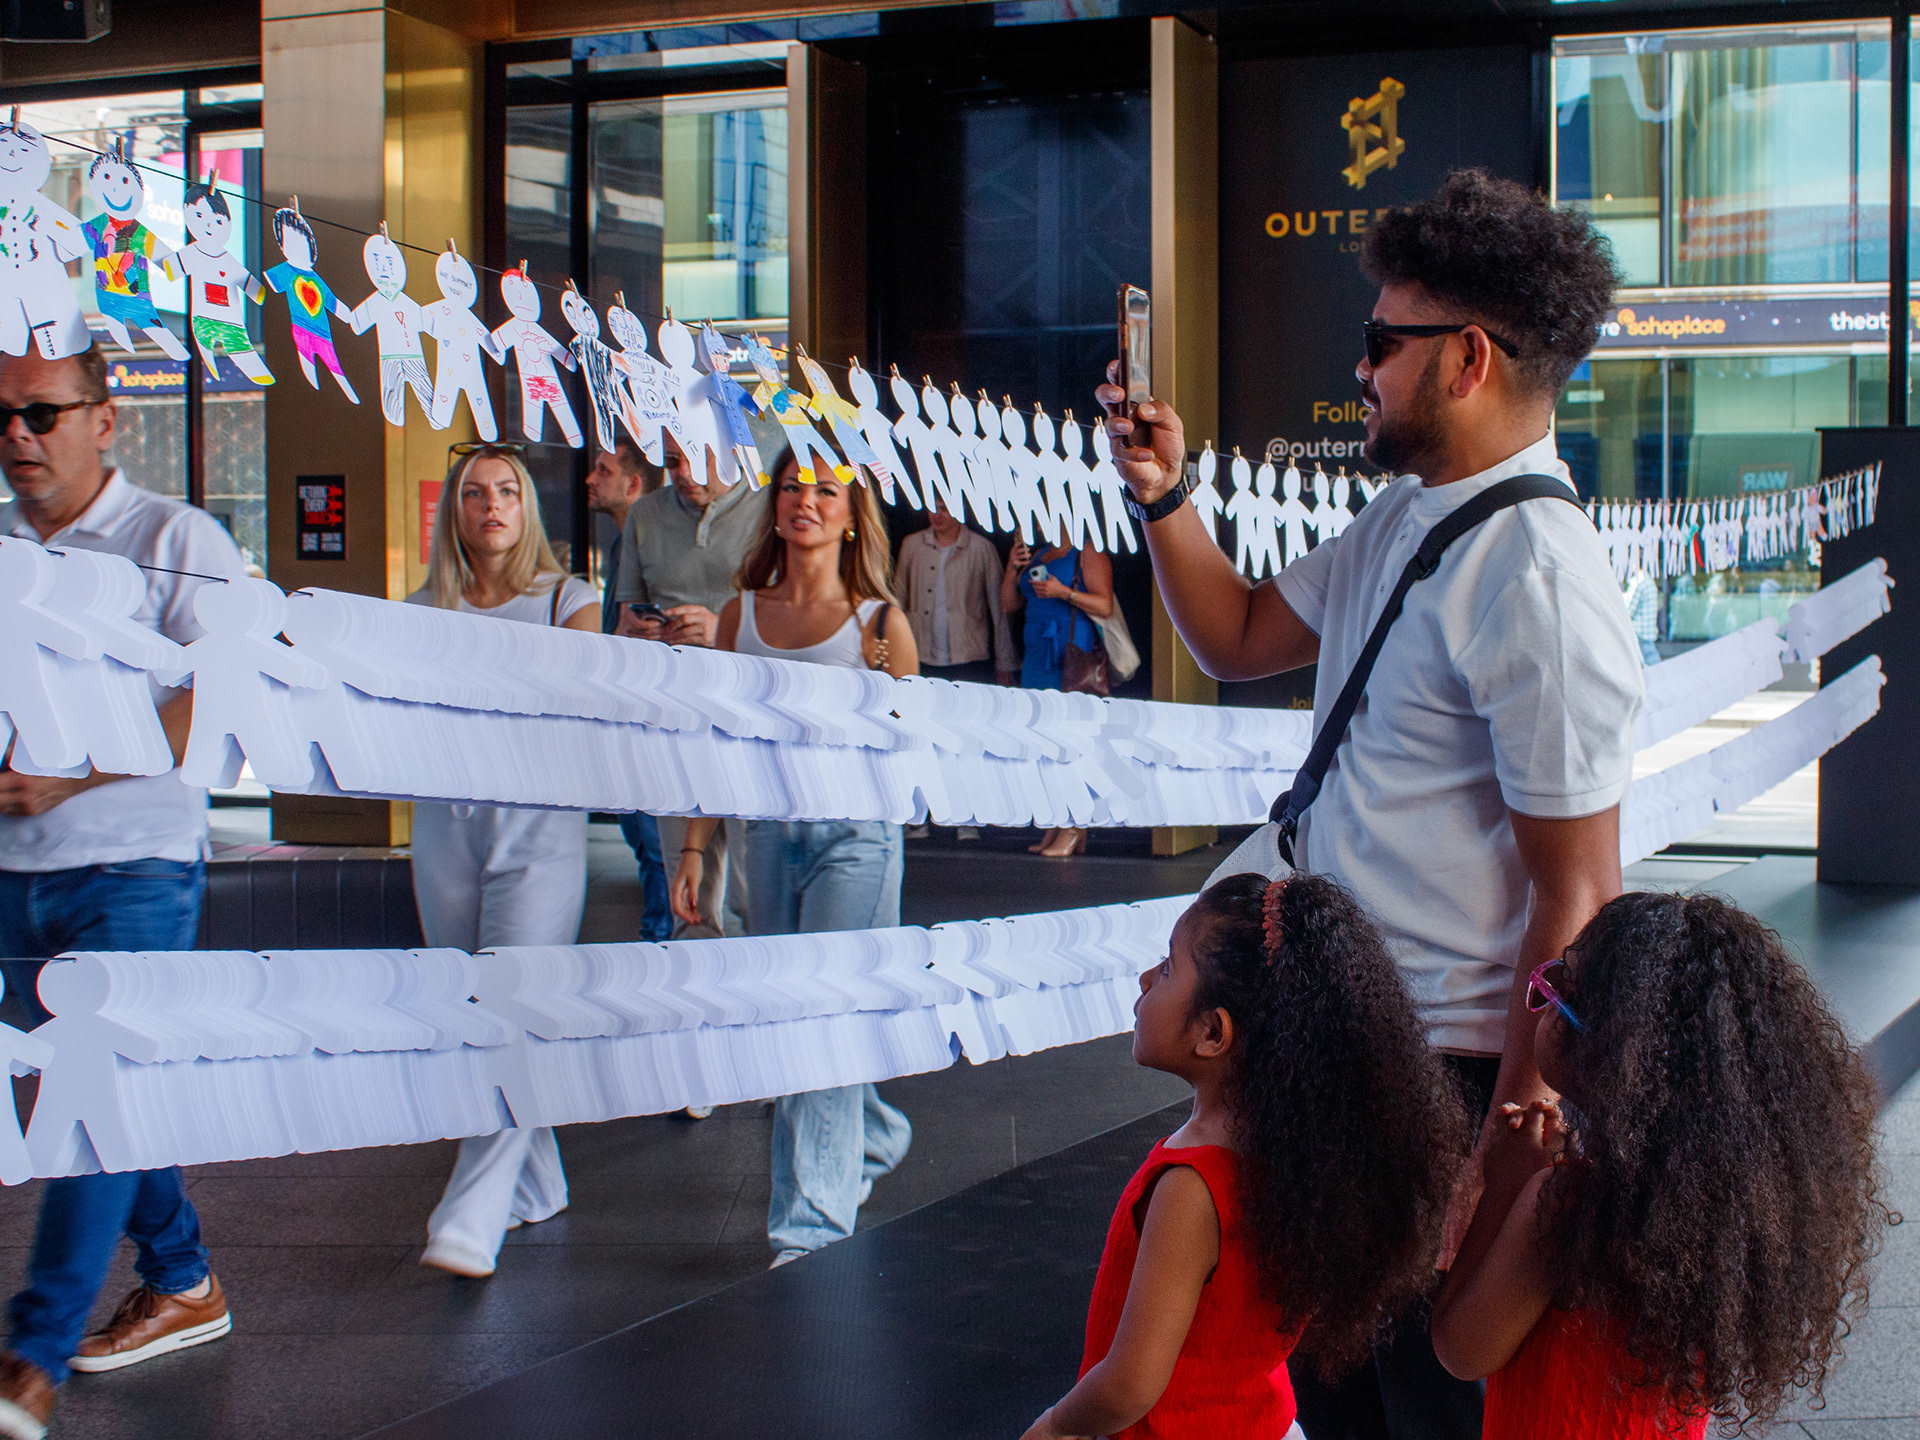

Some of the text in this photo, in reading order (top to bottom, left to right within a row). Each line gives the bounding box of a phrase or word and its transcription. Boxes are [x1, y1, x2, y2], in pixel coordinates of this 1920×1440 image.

[1265, 207, 1412, 238] OUTE
[1829, 311, 1890, 331] theat
[1313, 401, 1372, 423] Follo
[1288, 696, 1314, 710] Joi
